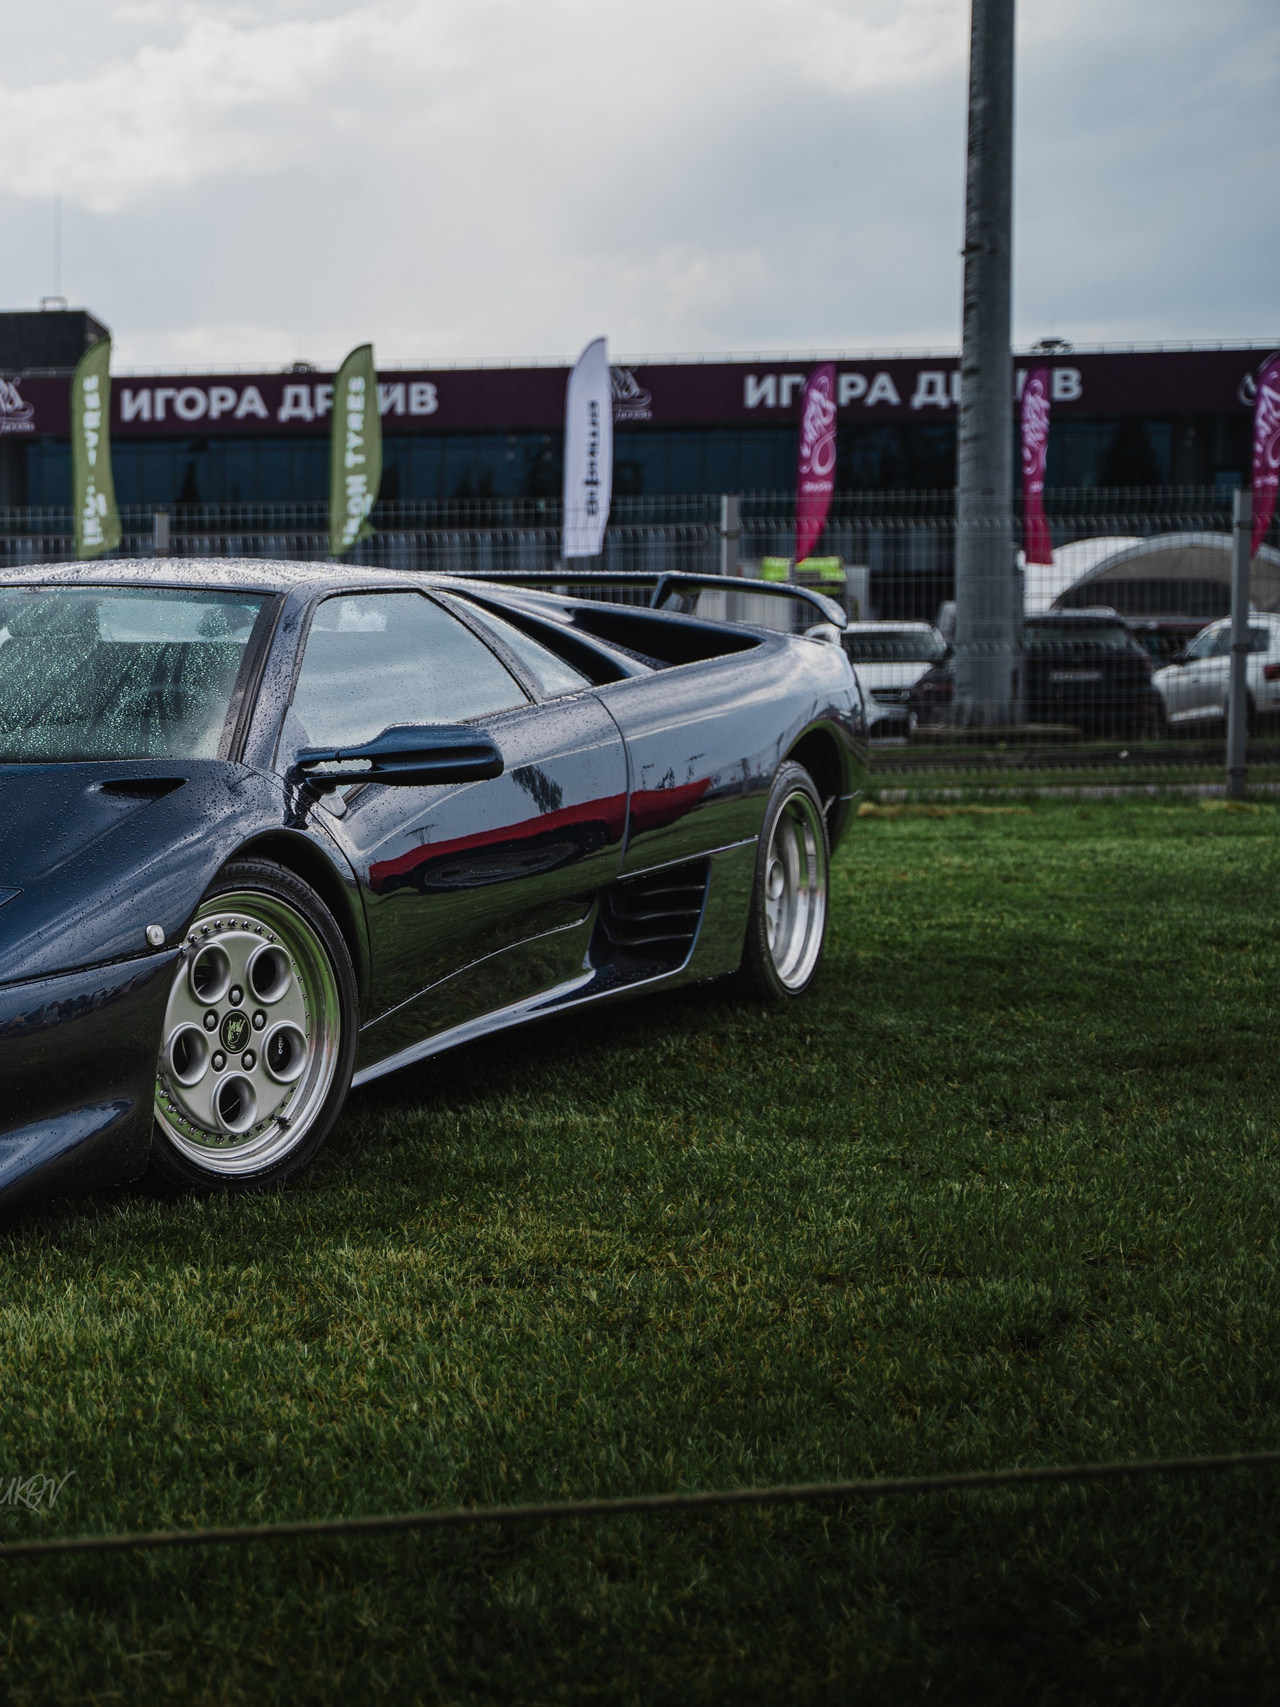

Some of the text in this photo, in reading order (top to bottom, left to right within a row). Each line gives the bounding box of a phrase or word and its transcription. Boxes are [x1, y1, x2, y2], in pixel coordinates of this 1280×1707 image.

[120, 381, 439, 423] ИГОРА ДРЙВ
[743, 371, 902, 410] ИГРА
[344, 376, 366, 469] TYRES
